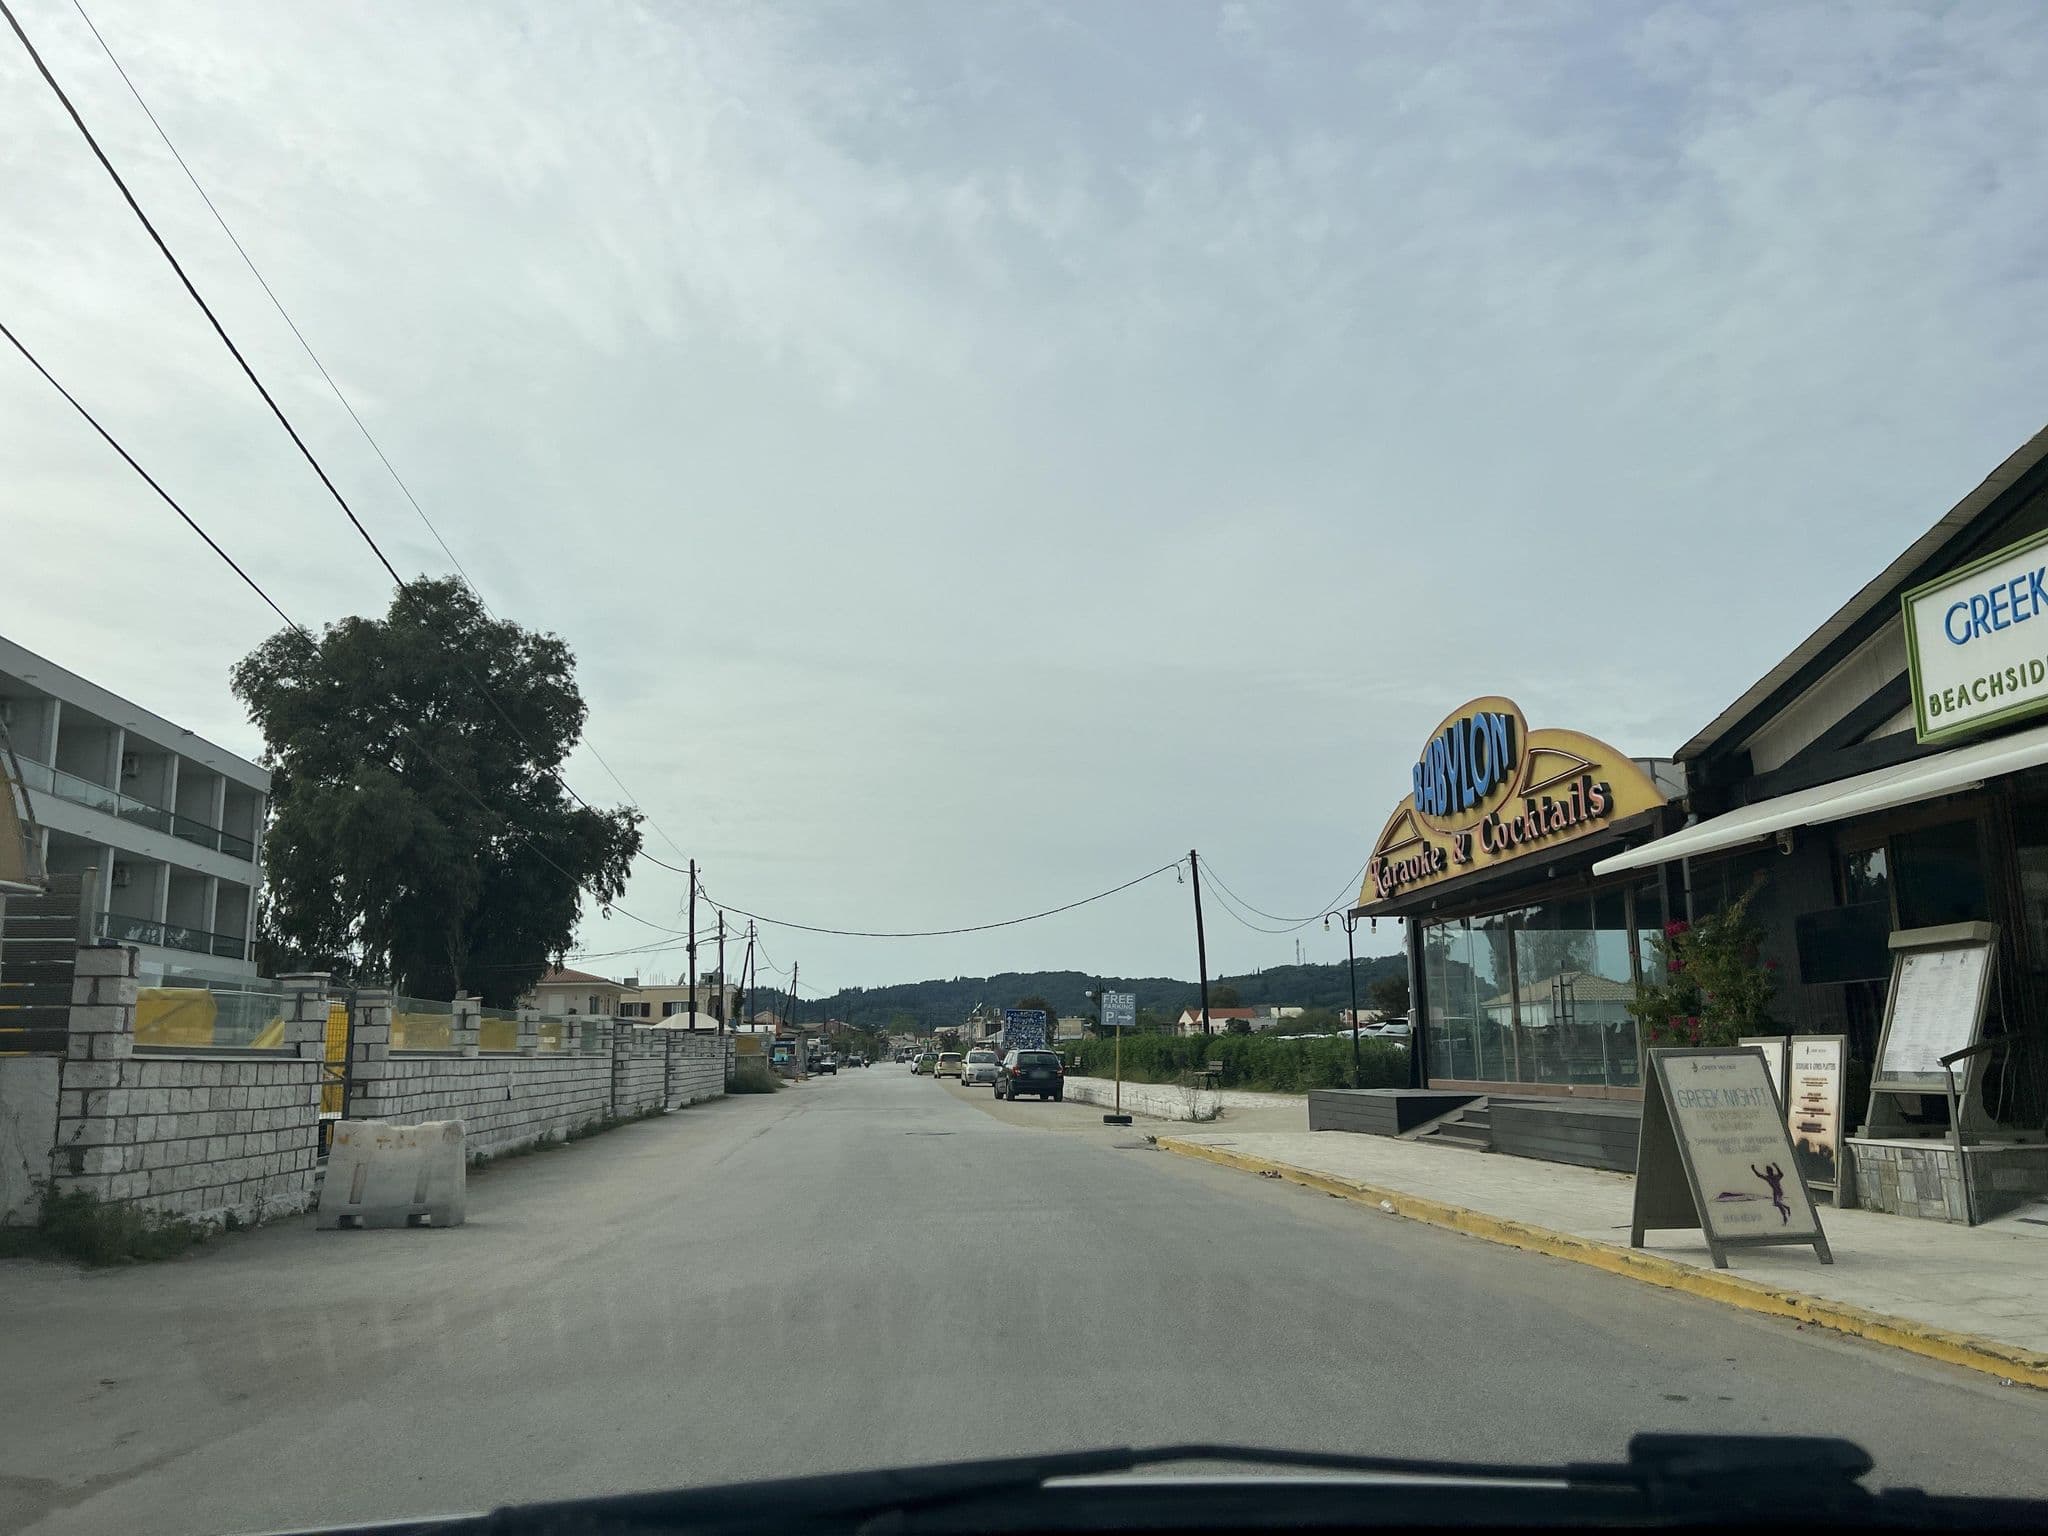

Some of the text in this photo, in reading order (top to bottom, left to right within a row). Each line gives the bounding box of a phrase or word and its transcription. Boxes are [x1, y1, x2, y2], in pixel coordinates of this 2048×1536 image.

[1945, 566, 2048, 645] GREEK
[1928, 656, 2048, 717] BEACHSID
[1412, 712, 1511, 817] BABYLON
[1370, 775, 1608, 898] Karaoke & Cocktails
[1103, 994, 1134, 1004] FREE
[1105, 1011, 1115, 1022] P
[1677, 1089, 1718, 1108] GREEK
